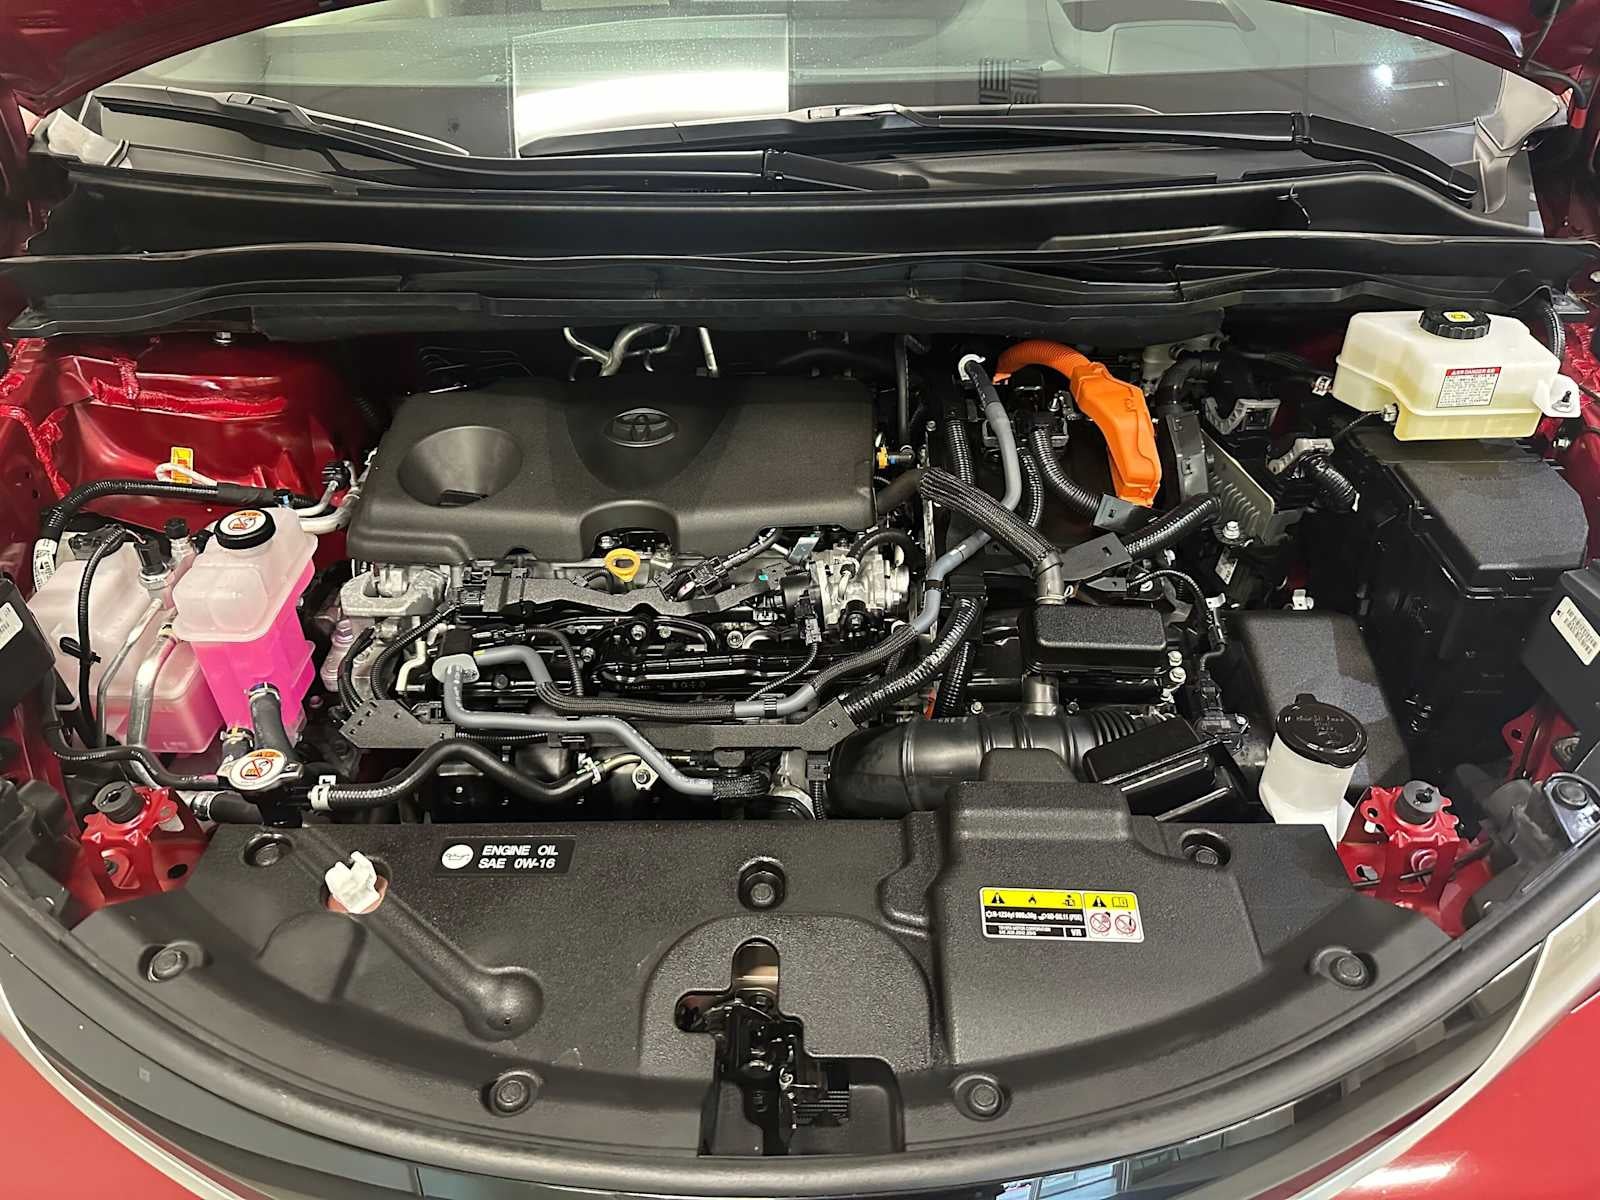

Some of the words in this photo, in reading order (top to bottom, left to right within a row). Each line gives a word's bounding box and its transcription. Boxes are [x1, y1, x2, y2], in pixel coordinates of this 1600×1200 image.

[482, 845, 531, 856] ENGINE
[537, 845, 559, 856] OIL
[478, 858, 507, 869] SAE
[514, 858, 556, 869] 0W-16
